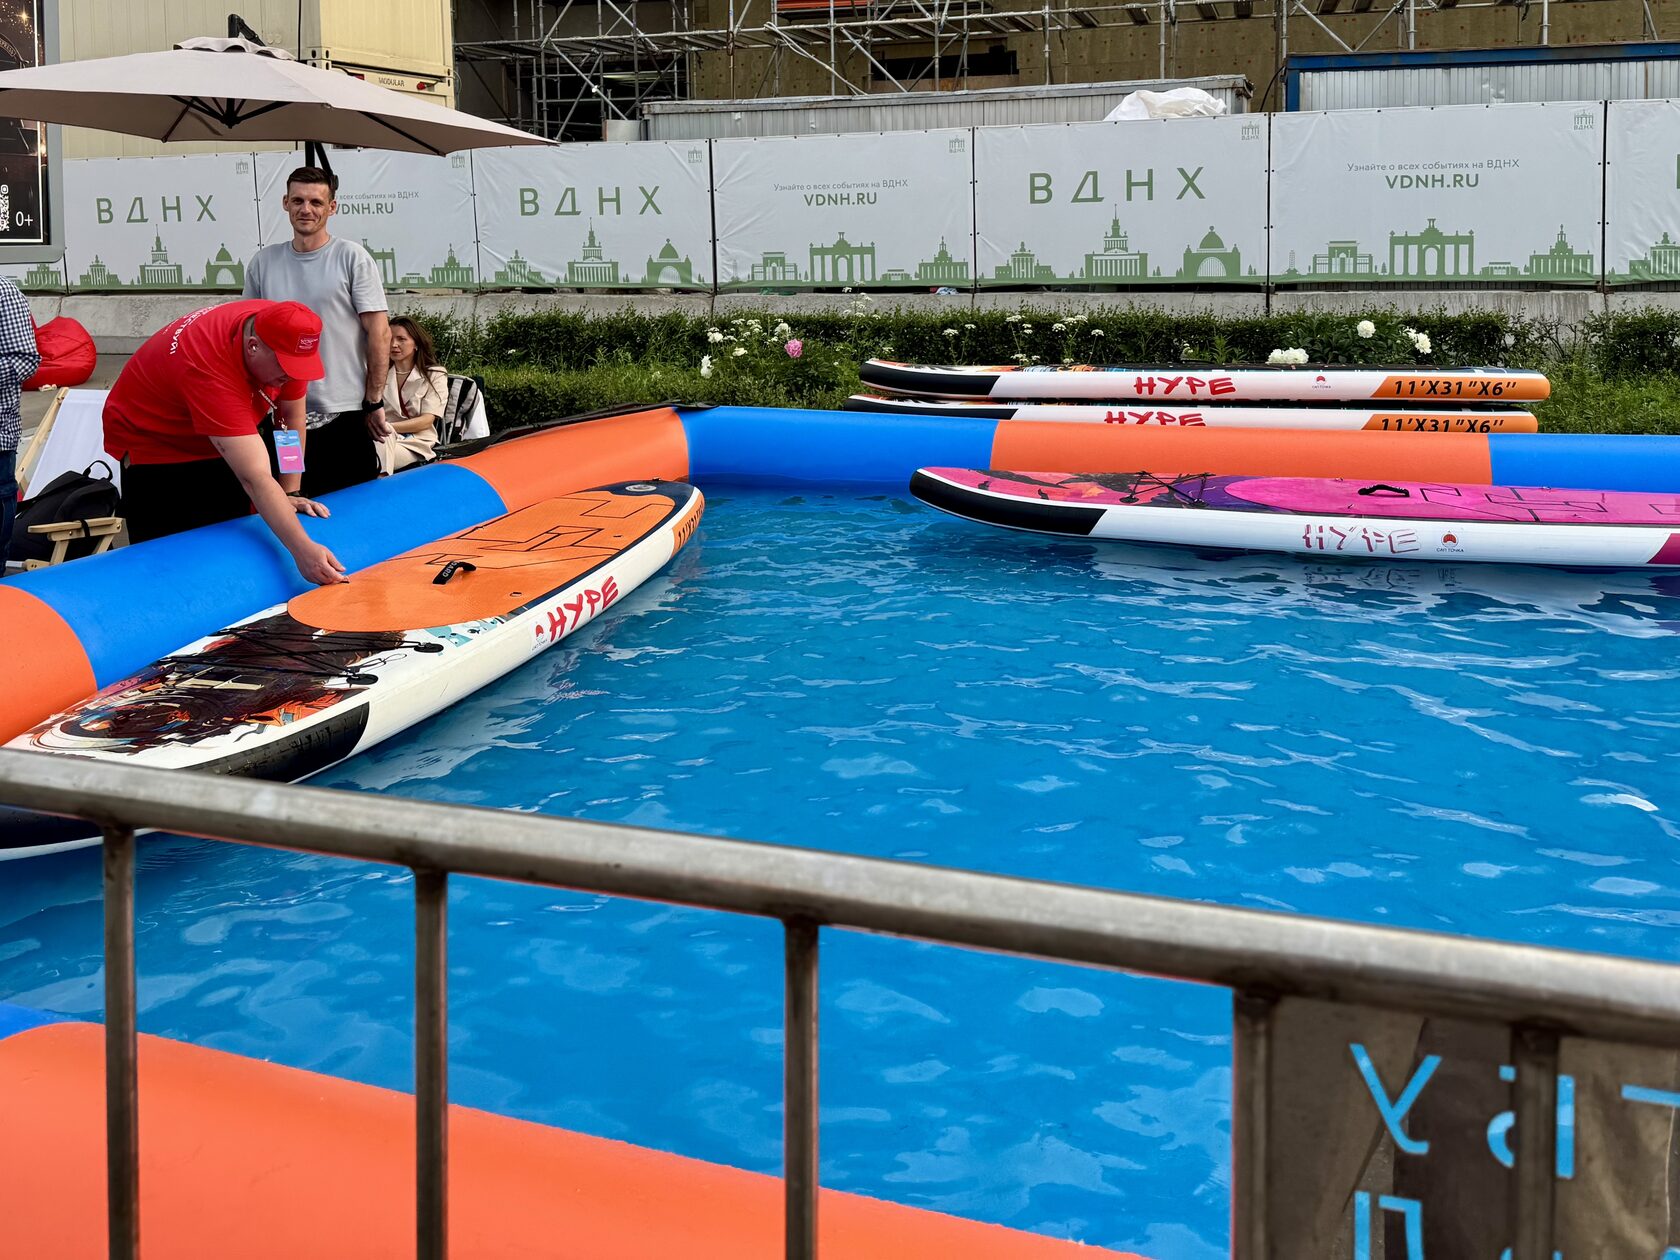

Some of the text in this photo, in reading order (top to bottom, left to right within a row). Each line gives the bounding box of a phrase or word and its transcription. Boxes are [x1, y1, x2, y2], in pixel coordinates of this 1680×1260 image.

[1347, 163, 1387, 172] Узнайте
[1399, 163, 1420, 171] всех
[1422, 161, 1470, 170] событиях
[1487, 159, 1520, 170] ВДНХ
[774, 183, 805, 191] Узнайте
[832, 181, 869, 189] событиях
[882, 179, 908, 188] ВДНХ
[1029, 166, 1206, 204] ВДНХ
[1385, 173, 1479, 189] VDNH.RU
[398, 191, 420, 199] ВДНХ
[519, 185, 663, 216] ВДНХ
[804, 192, 878, 206] VDNH.RU
[96, 195, 217, 224] ВДНХ
[15, 211, 34, 227] 0+
[1133, 376, 1236, 396] HYPE
[1104, 411, 1206, 427] HYPE
[1302, 523, 1422, 554] HYPE
[547, 575, 619, 643] HYPE
